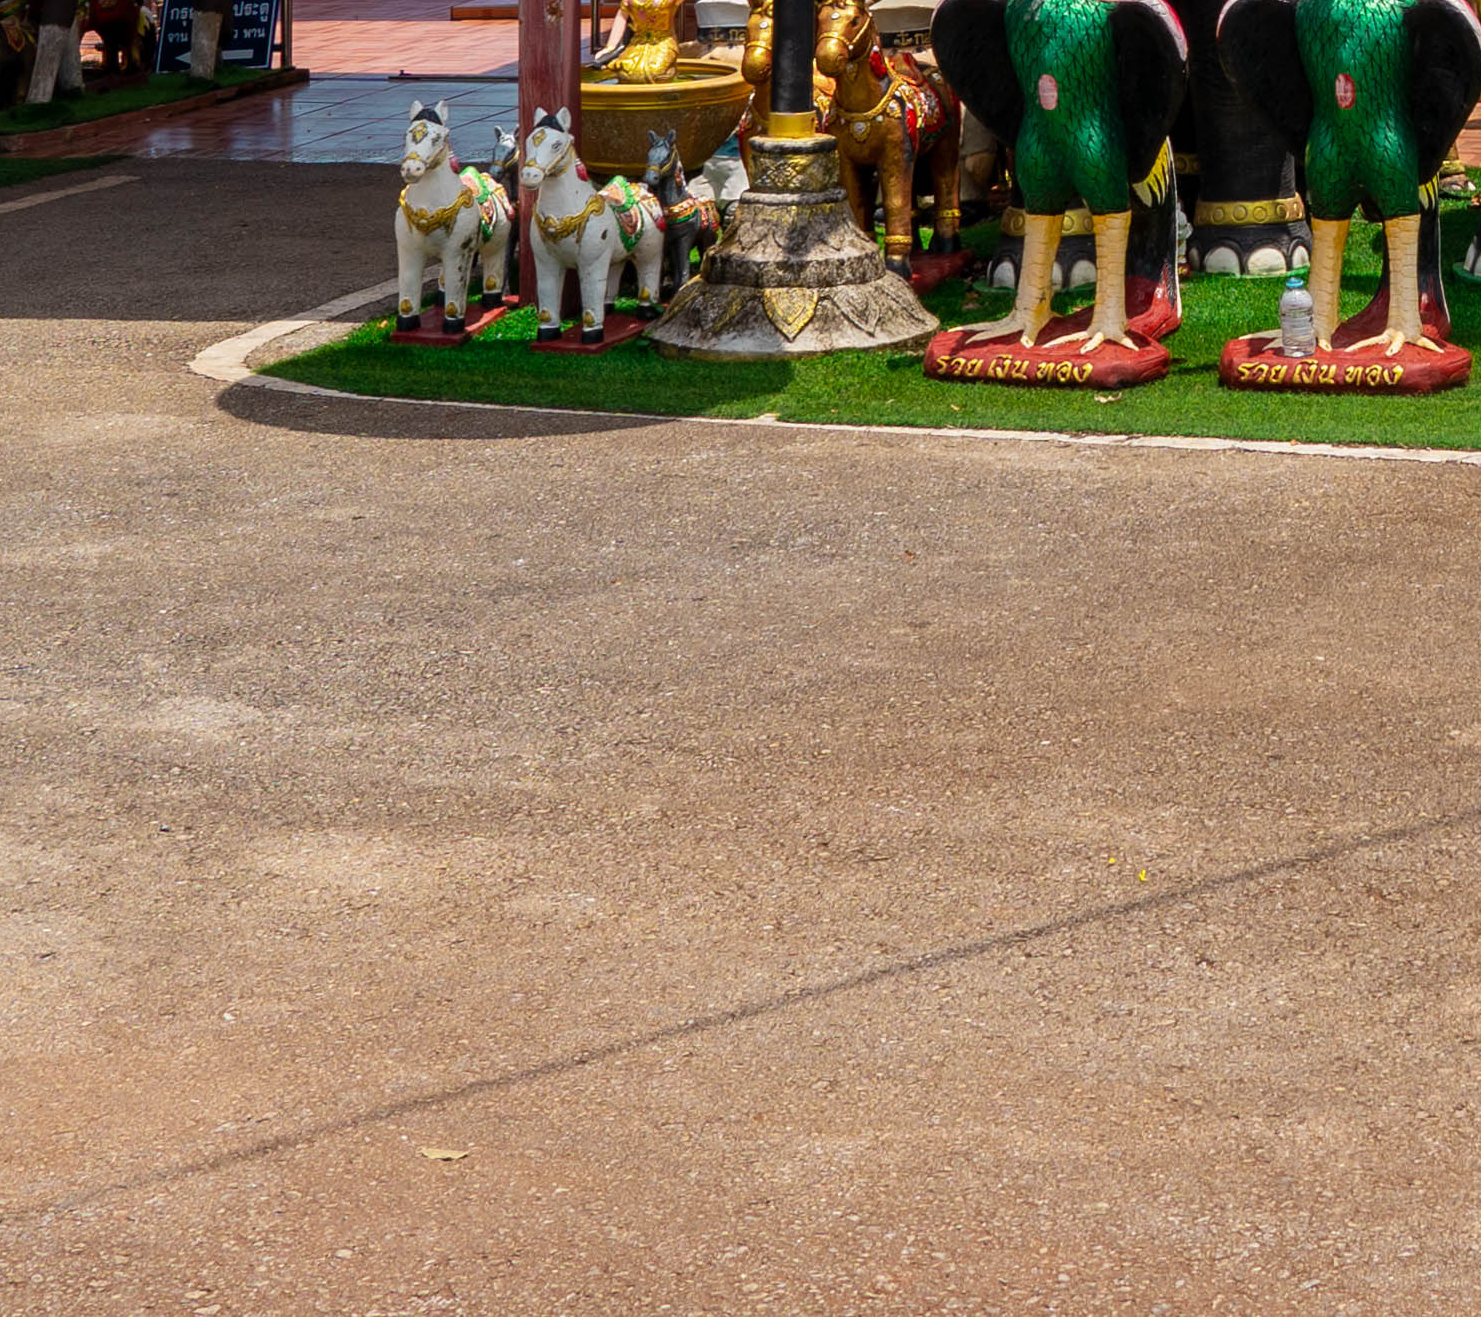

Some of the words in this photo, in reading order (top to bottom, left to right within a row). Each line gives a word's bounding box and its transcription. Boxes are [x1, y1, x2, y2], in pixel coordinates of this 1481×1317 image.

[935, 355, 984, 378] รวย
[987, 353, 1030, 381] เงิน
[1035, 360, 1094, 383] ทอง
[1237, 361, 1289, 384] รวย
[1292, 358, 1338, 385] เงิน
[1344, 363, 1406, 387] ทอง
